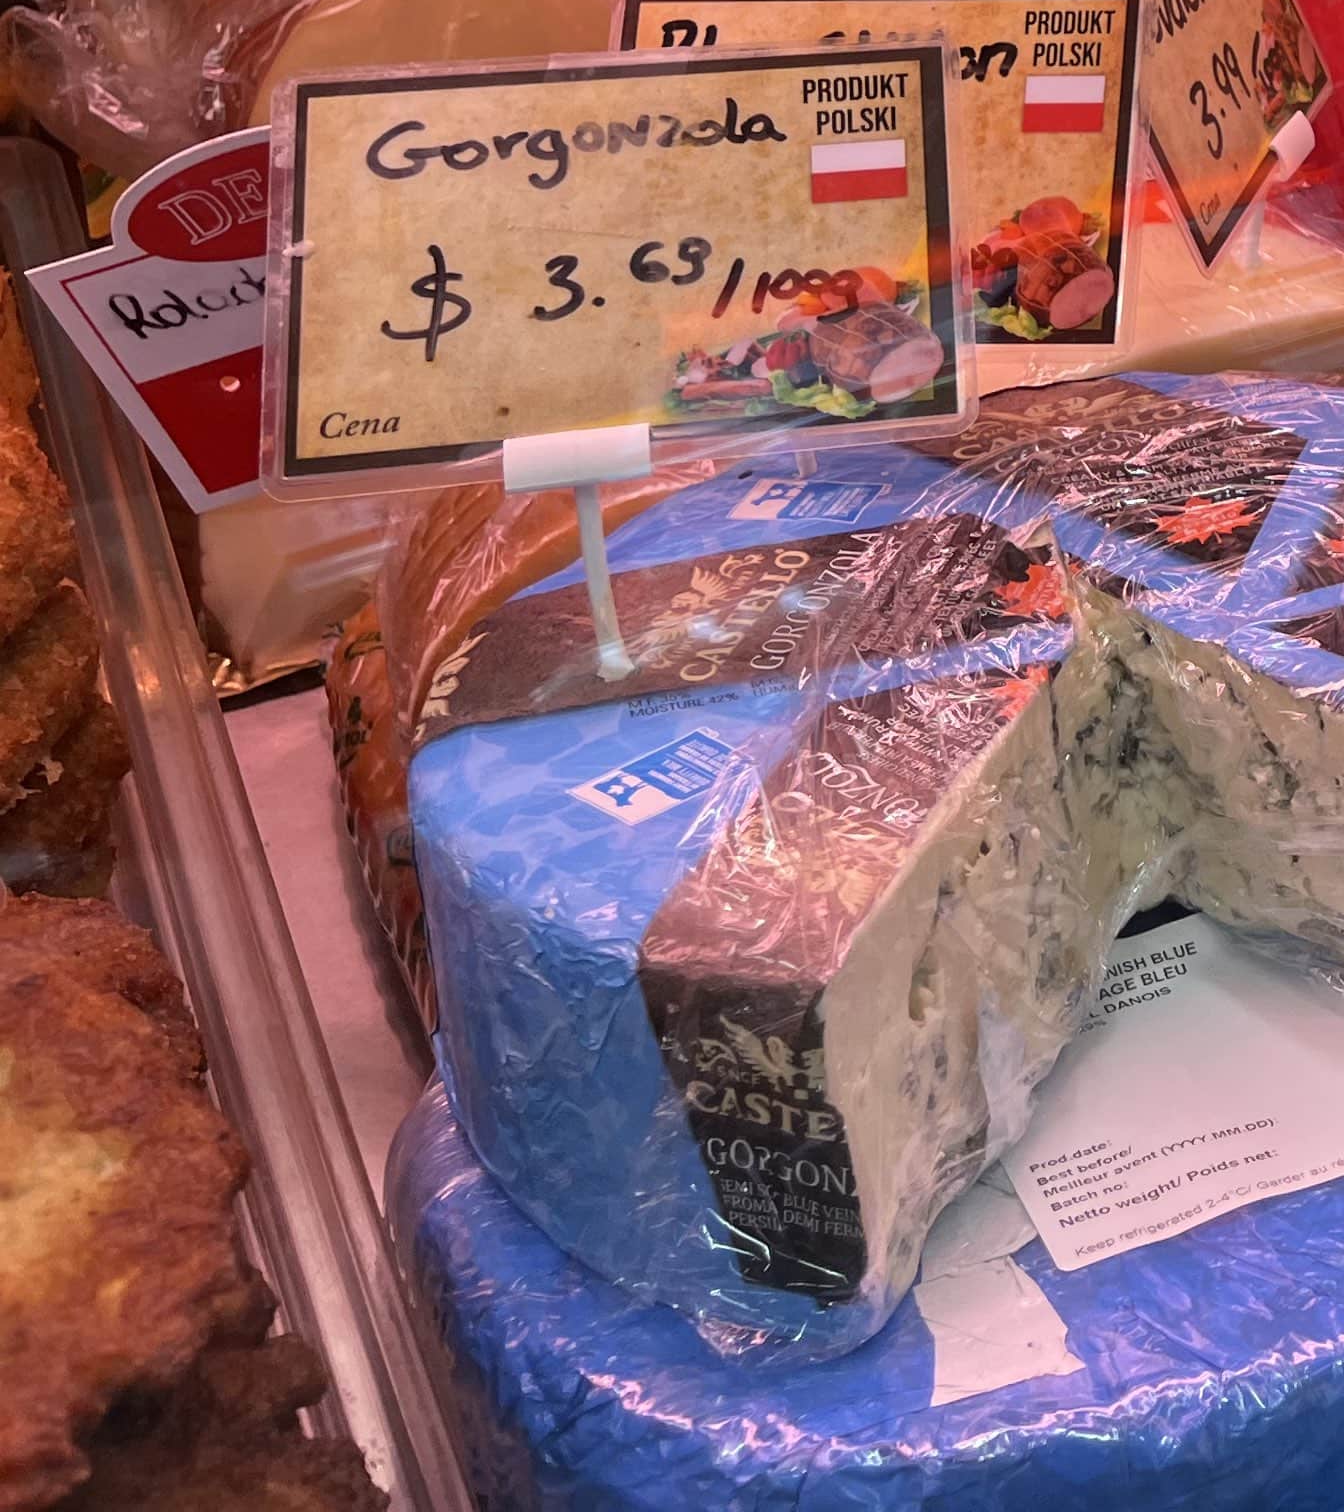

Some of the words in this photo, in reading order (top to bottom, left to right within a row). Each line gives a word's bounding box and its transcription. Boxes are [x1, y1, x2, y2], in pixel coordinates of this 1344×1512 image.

[1023, 10, 1116, 36] PRODUKT
[1032, 43, 1103, 67] POLSKI
[802, 73, 909, 104] PRODUKT
[815, 105, 897, 136] POLSKI
[158, 168, 269, 246] DE
[380, 244, 473, 362] $
[320, 410, 400, 440] Cena
[708, 691, 740, 707] 42%
[1103, 957, 1147, 980] NISH
[1150, 941, 1198, 965] BLUE
[1140, 962, 1188, 987] BLEU
[1103, 986, 1172, 1015] DANOIS
[686, 1079, 848, 1144] CASTE
[706, 1137, 857, 1197] GORGON
[1036, 1169, 1074, 1187] Best
[1043, 1171, 1110, 1198] Meilleur
[1050, 1189, 1098, 1213] Batch
[1102, 1180, 1129, 1196] no:
[1059, 1204, 1112, 1229] Netto
[1114, 1175, 1182, 1214] weight/
[1186, 1157, 1240, 1182] Poids
[1243, 1147, 1280, 1166] net:
[722, 1193, 779, 1215] FROMA
[1074, 1237, 1116, 1257] Keep
[1118, 1203, 1204, 1242] refrigerated
[1256, 1172, 1305, 1191] Garder
[1309, 1165, 1328, 1177] au
[783, 1209, 821, 1233] DEMI
